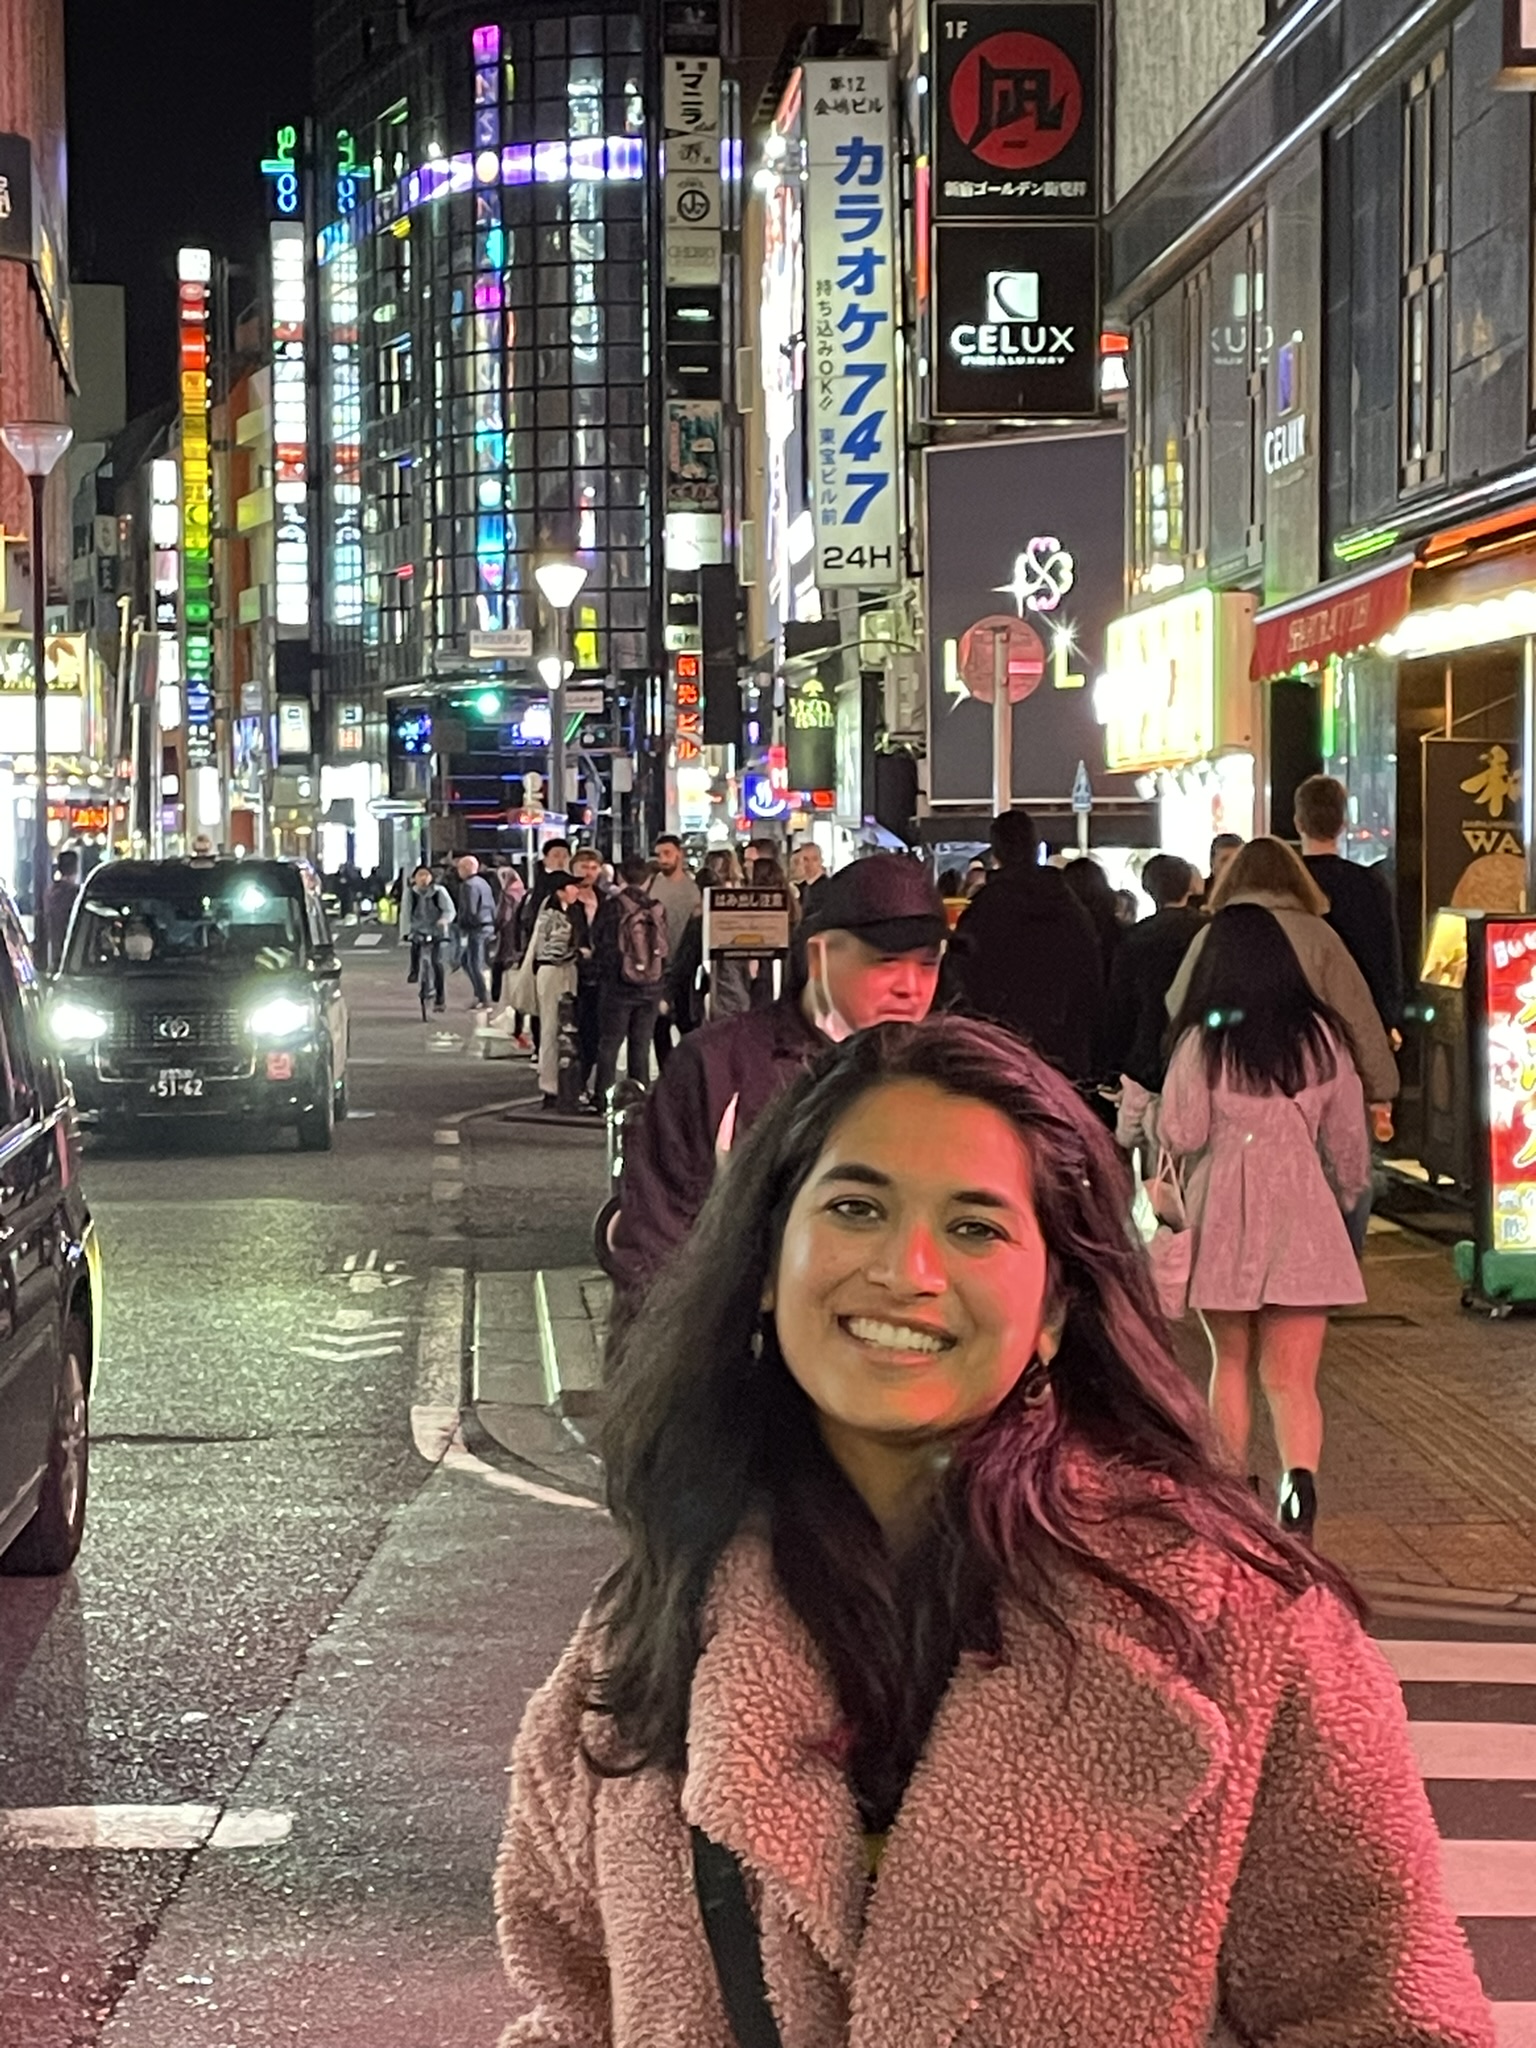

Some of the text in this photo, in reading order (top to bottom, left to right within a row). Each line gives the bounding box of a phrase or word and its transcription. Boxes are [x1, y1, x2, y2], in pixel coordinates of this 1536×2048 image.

[945, 21, 968, 39] 1F
[950, 324, 1075, 355] CELUX
[819, 428, 838, 526] 東宝ビル前
[823, 545, 892, 570] 24H
